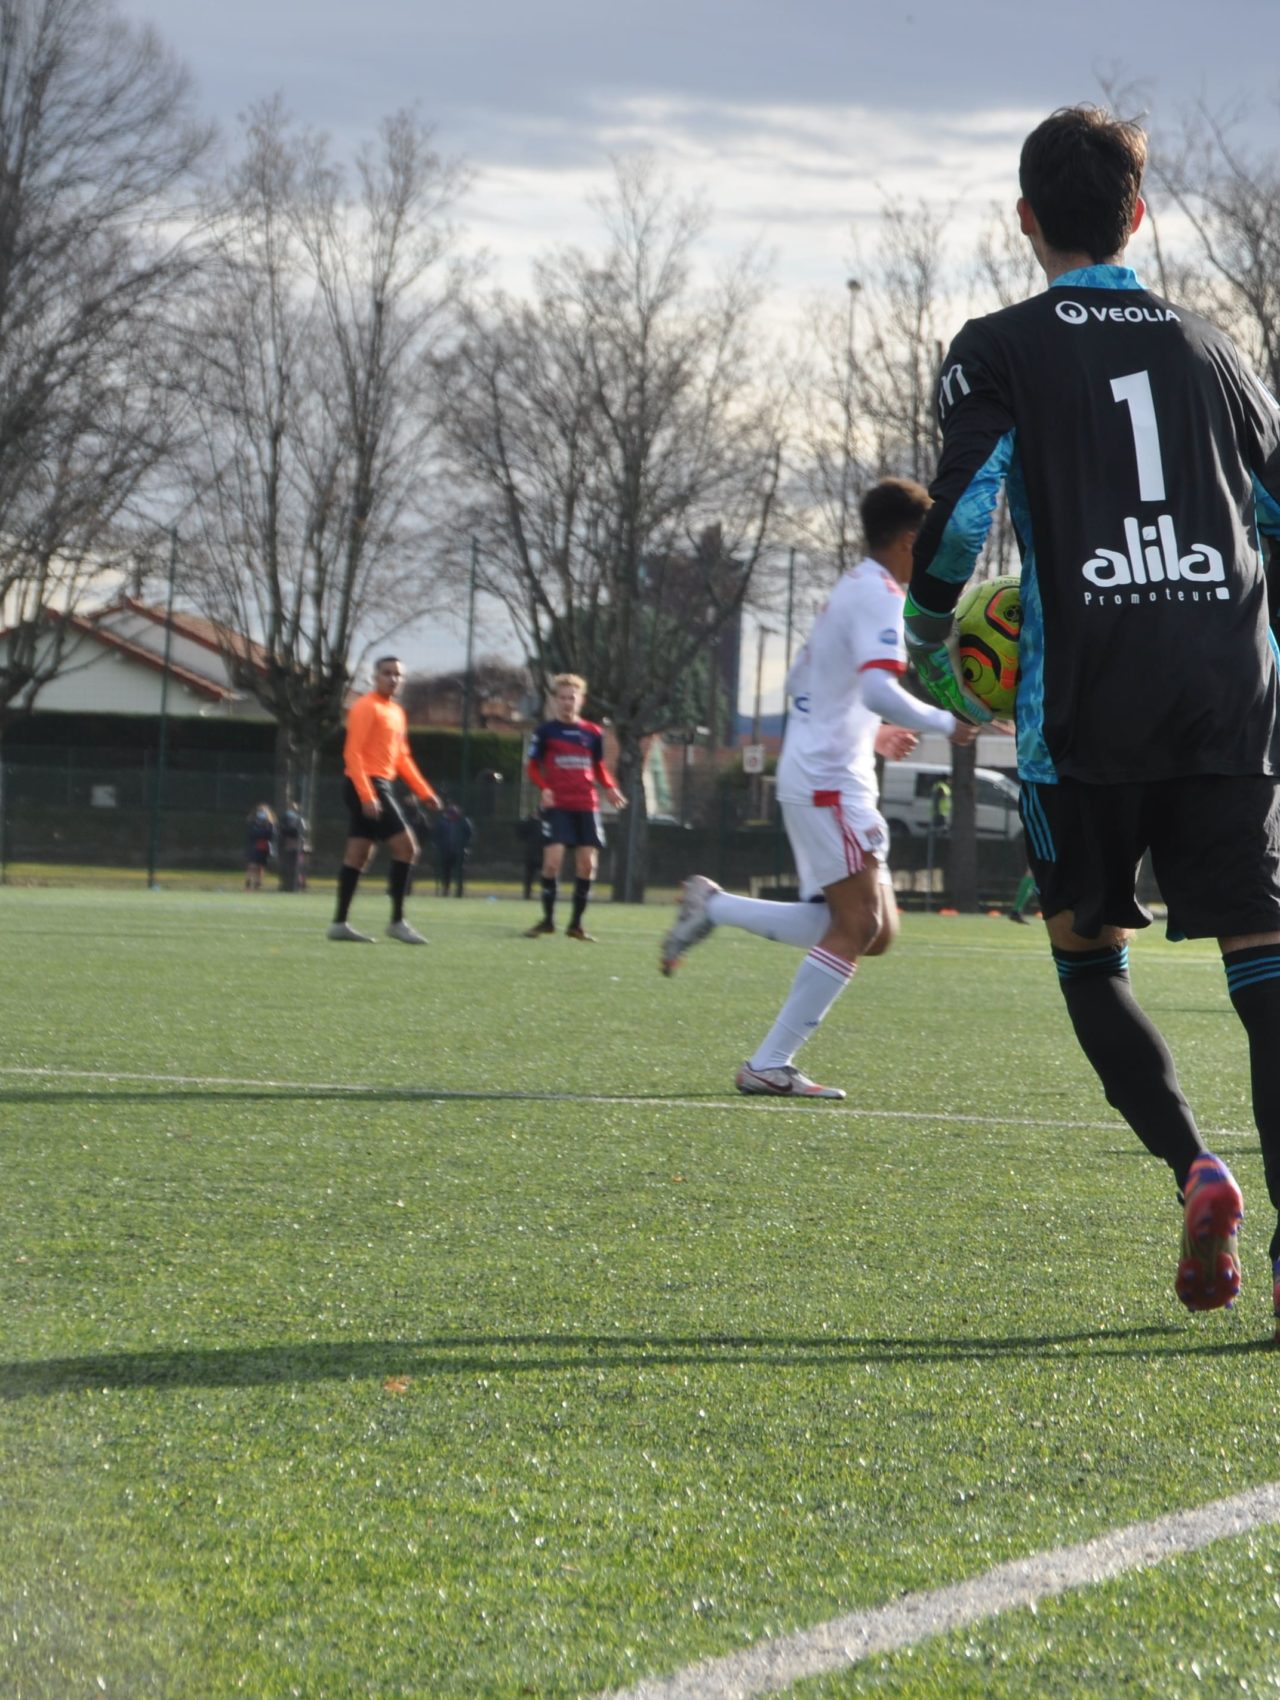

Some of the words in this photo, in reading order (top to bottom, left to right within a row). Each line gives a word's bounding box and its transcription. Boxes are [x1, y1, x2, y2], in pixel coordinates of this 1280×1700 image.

[1089, 306, 1182, 323] VEOLIA
[1109, 369, 1166, 502] 1
[1082, 514, 1226, 588] alila
[1084, 587, 1212, 606] Promoteur
